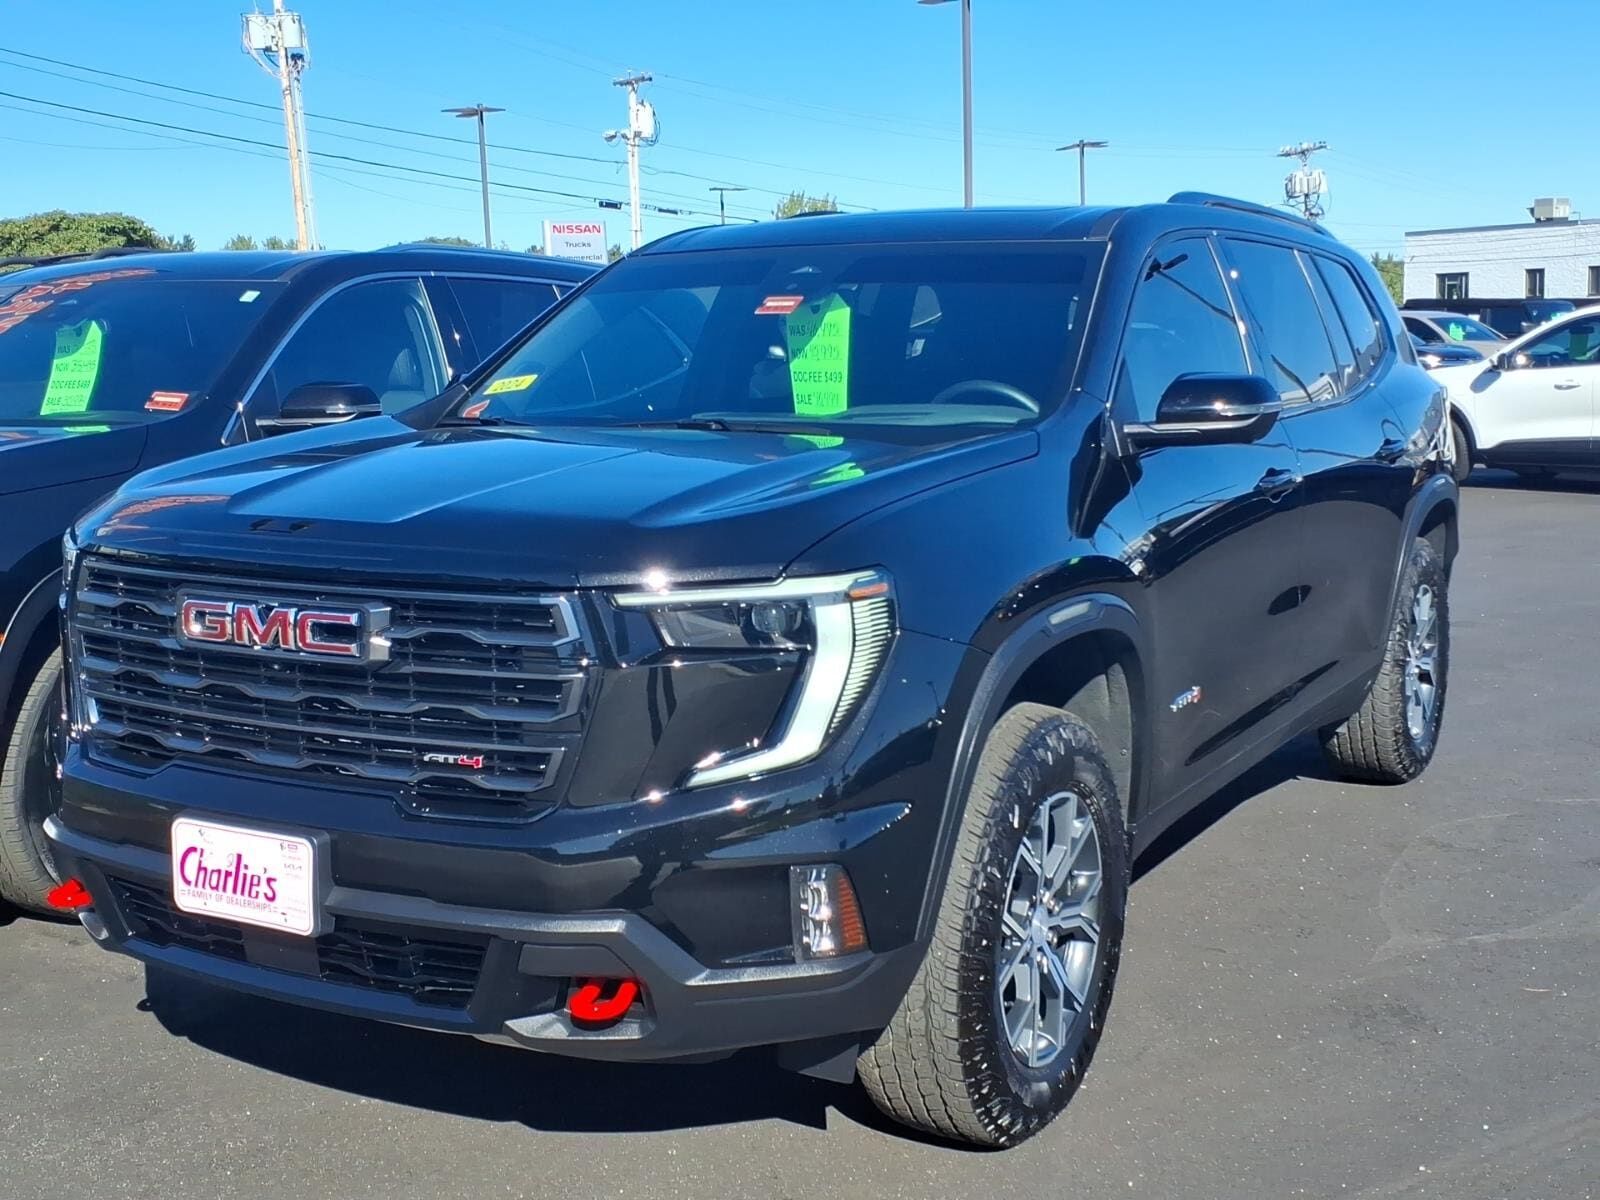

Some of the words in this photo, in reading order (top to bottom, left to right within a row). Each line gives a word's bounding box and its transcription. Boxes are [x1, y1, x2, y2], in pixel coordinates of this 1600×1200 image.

[552, 224, 601, 234] NISSAN
[788, 324, 807, 337] WAS
[824, 371, 843, 384] $499
[795, 393, 813, 406] SALE
[182, 599, 360, 656] GMC
[423, 753, 484, 769] AT4
[179, 845, 278, 903] Charlie's
[187, 888, 213, 901] FAMILY
[215, 894, 223, 903] OF
[226, 897, 272, 914] DEALERSHIPS
